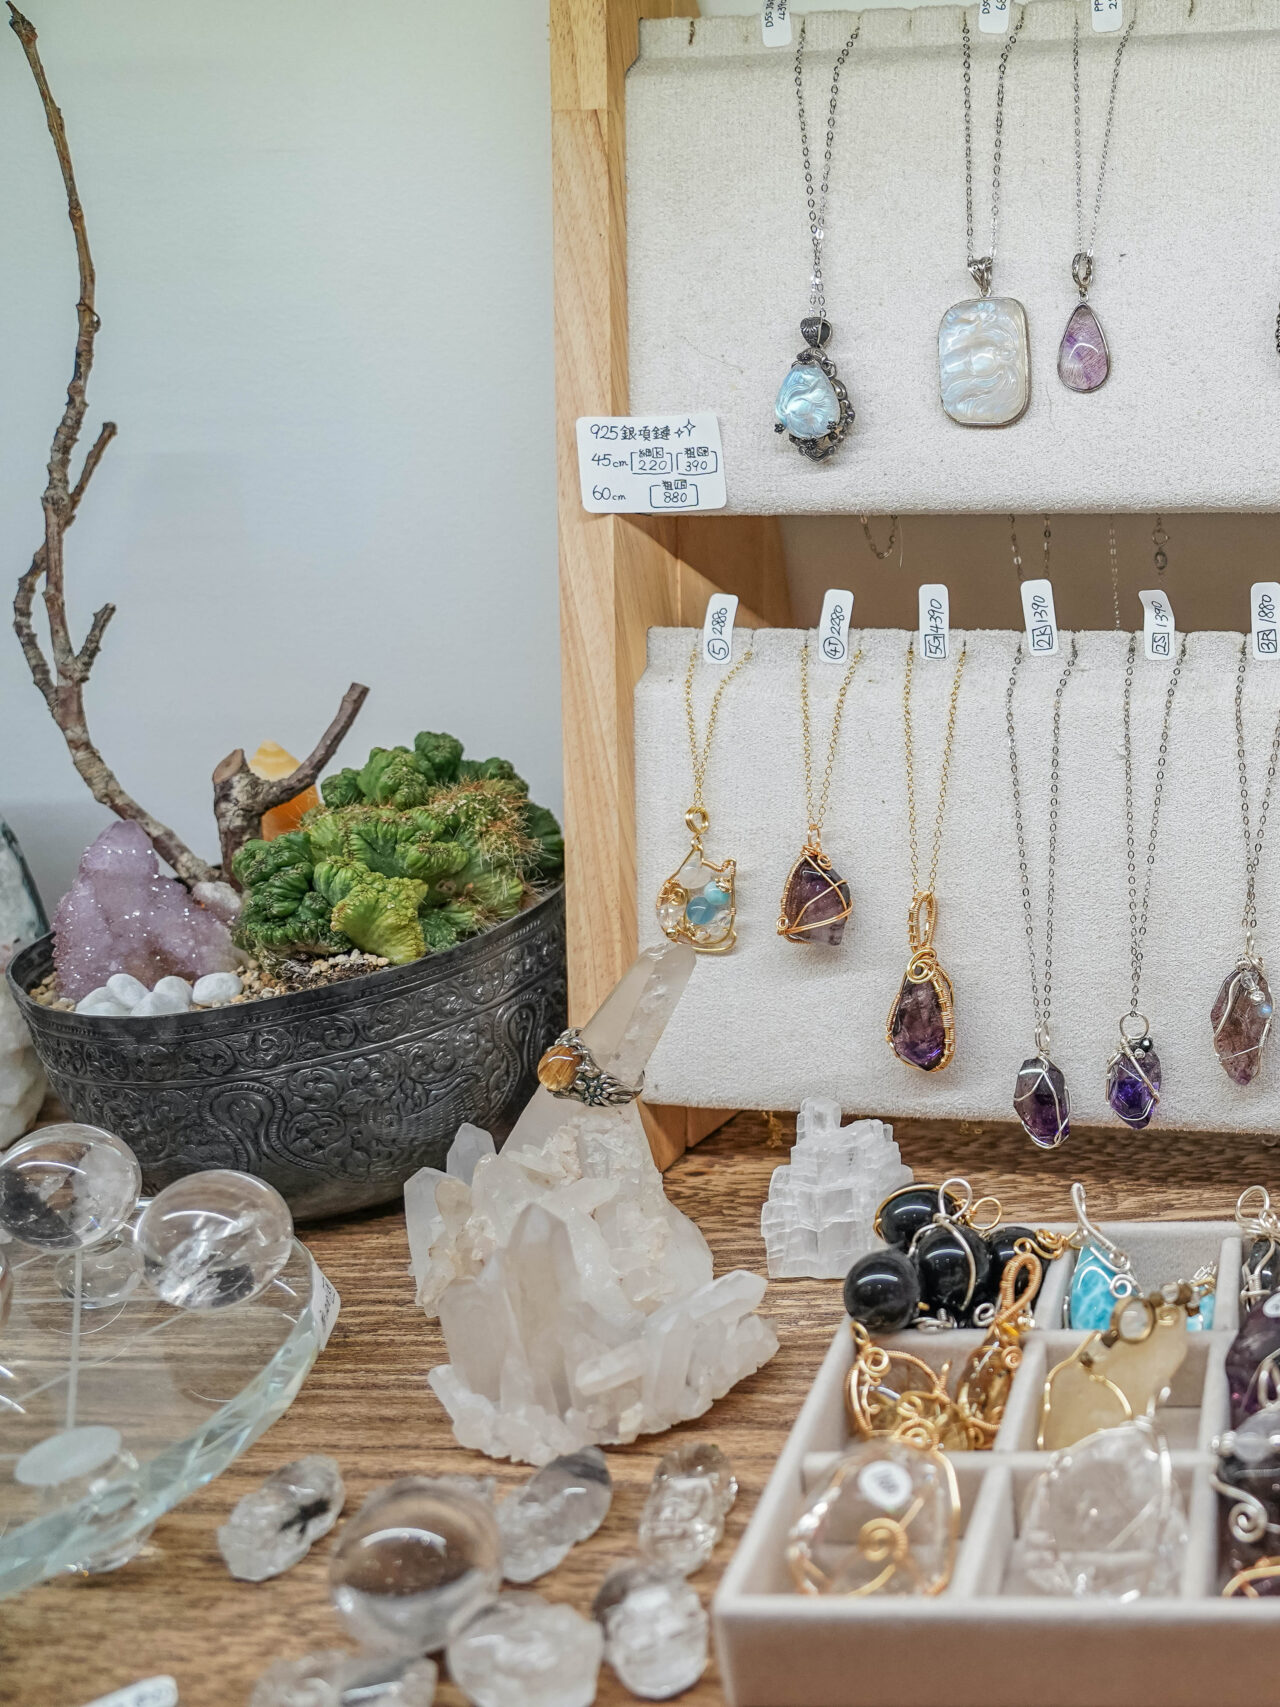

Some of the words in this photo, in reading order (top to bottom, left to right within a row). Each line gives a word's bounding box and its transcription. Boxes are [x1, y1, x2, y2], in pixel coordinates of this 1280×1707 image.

[638, 460, 667, 471] 220
[685, 460, 708, 472] 390
[664, 491, 687, 503] 880
[712, 608, 728, 635] 2880
[831, 605, 845, 636] 2280
[928, 599, 944, 633] 4390
[1033, 595, 1048, 623] 1390
[1152, 602, 1168, 627] 1390
[1258, 595, 1277, 623] 1880
